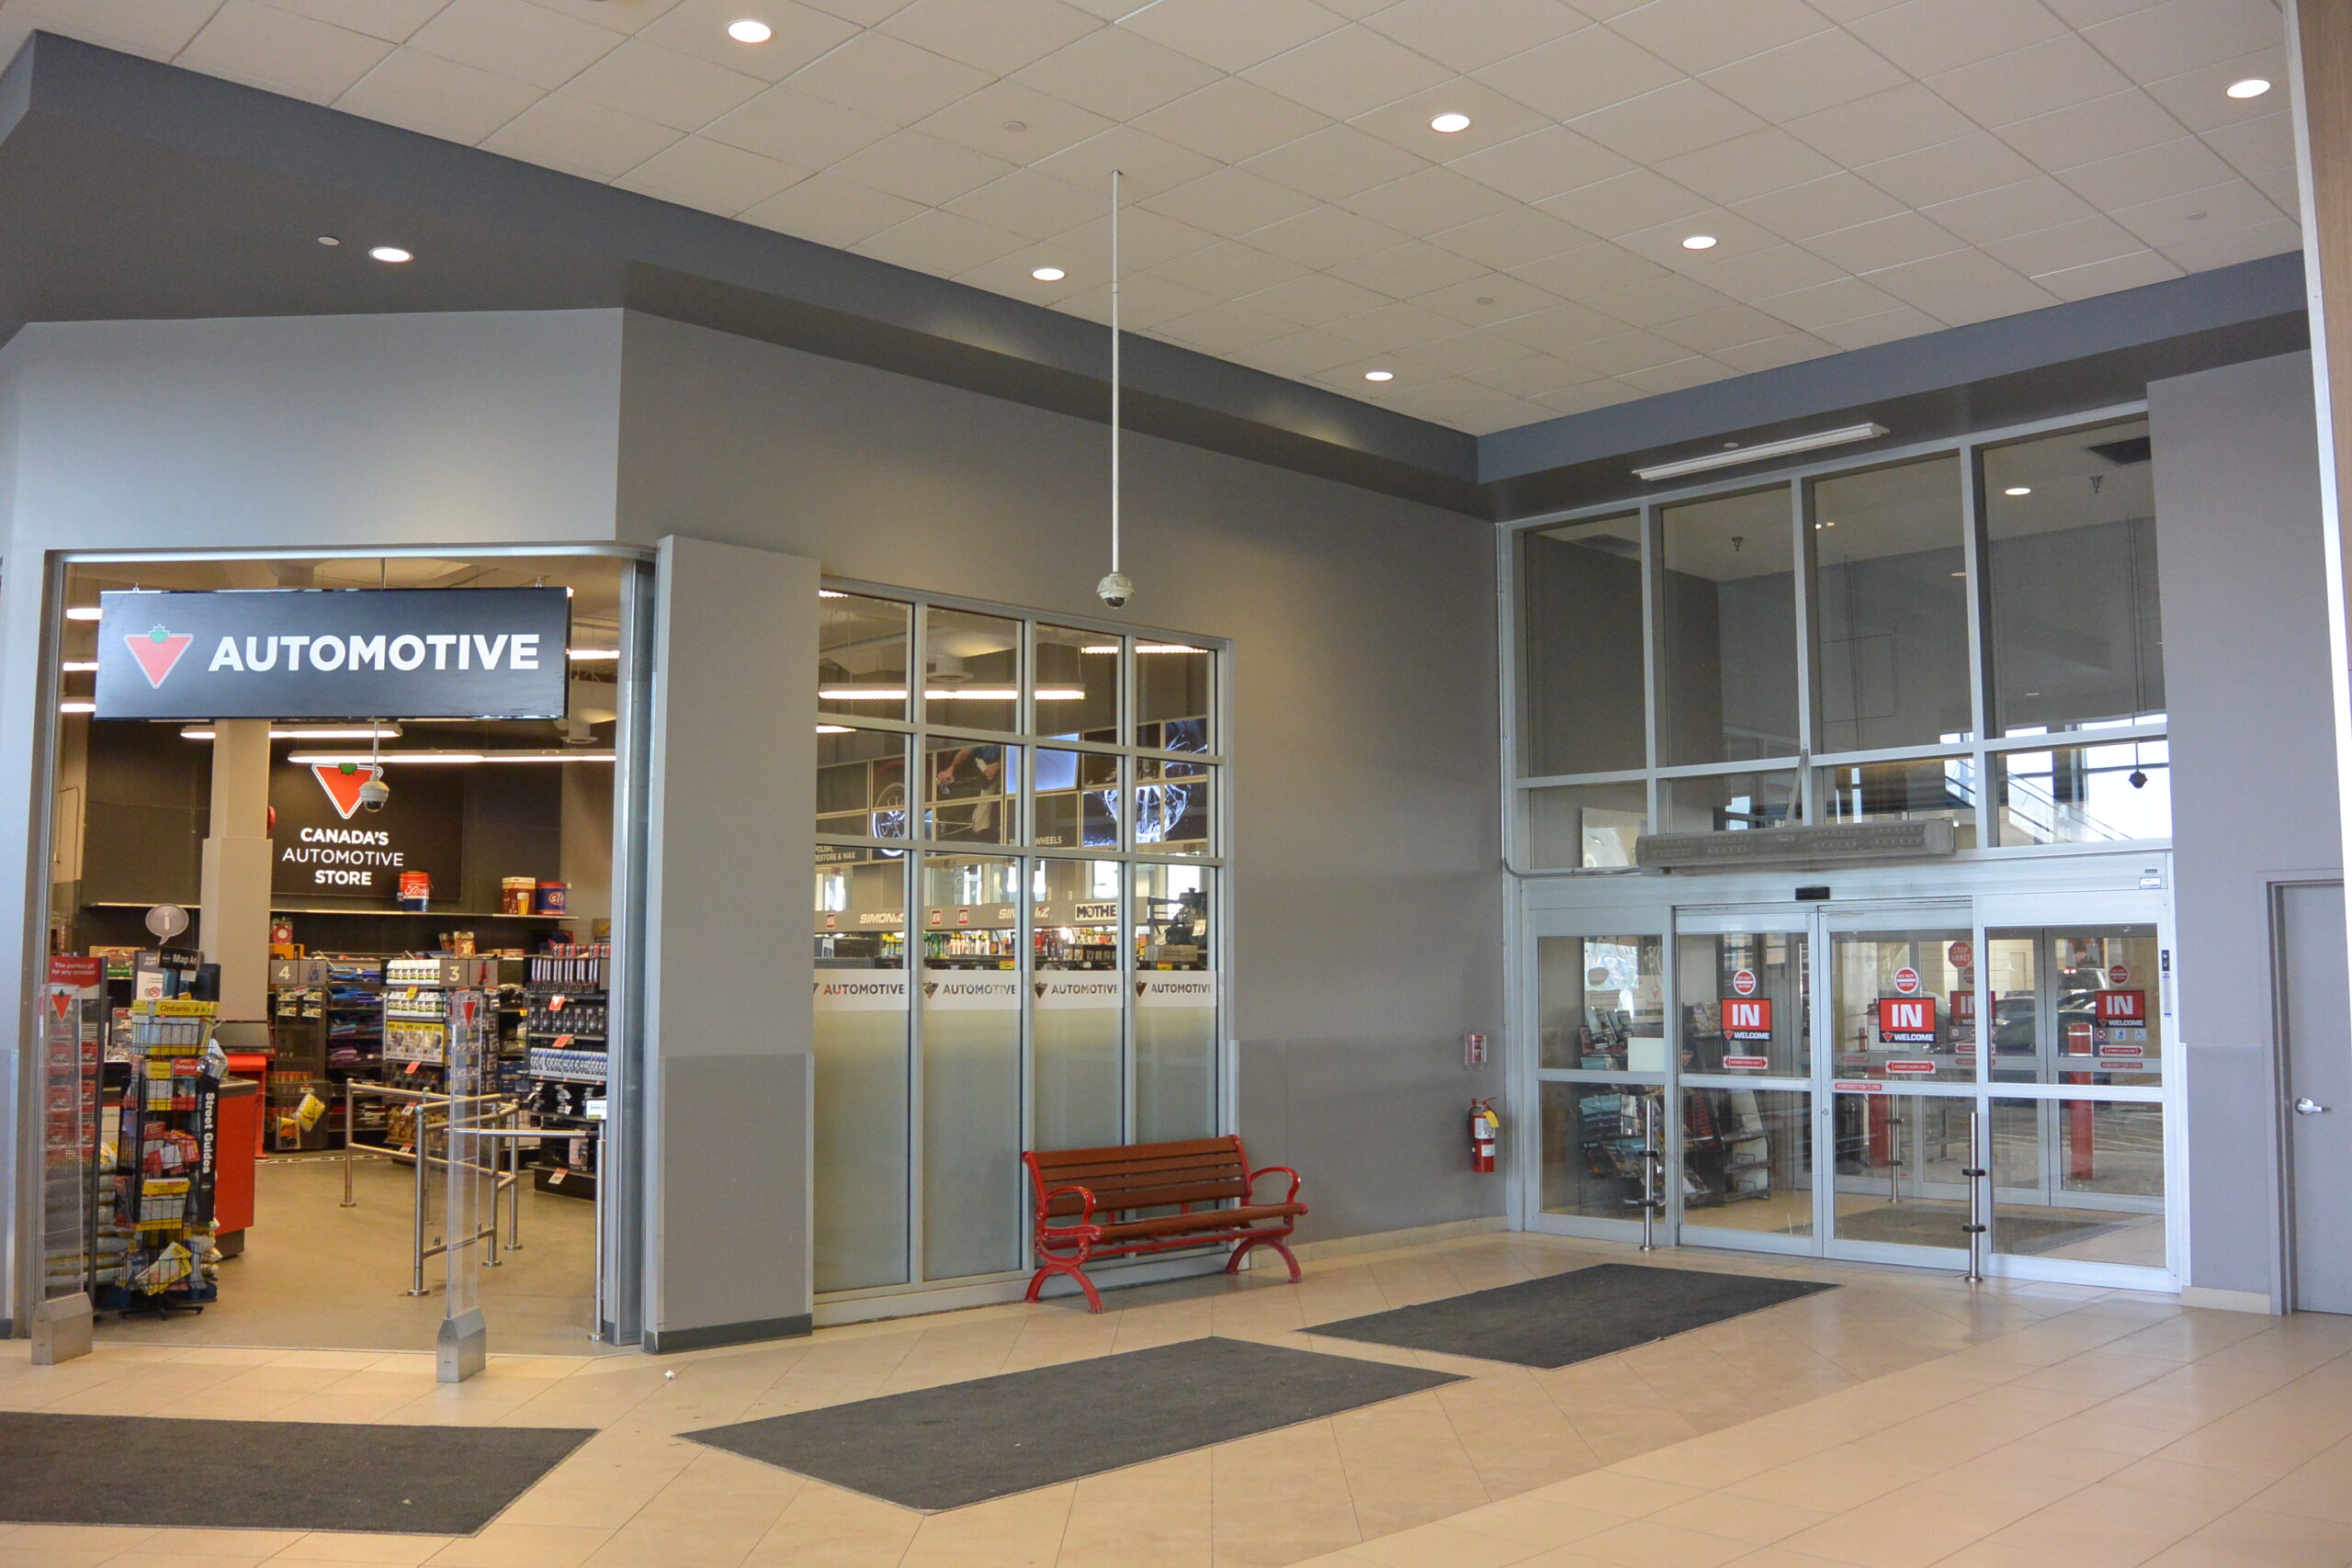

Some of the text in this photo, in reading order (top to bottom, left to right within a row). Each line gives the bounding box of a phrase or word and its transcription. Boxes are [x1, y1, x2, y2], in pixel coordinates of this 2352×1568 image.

[208, 634, 539, 671] AUTOMOTIVE
[300, 828, 390, 846] CANADA'S
[1035, 836, 1062, 845] WHEELS
[282, 847, 404, 866] AUTOMOTIVE
[314, 870, 372, 886] STORE
[173, 954, 189, 966] Map
[278, 965, 291, 980] 4
[448, 965, 460, 981] 3
[823, 984, 905, 996] AUTOMOTIVE
[943, 984, 1016, 996] AUTOMOTIVE
[1050, 984, 1117, 995] AUTOMOTIVE
[2106, 996, 2133, 1015] IN
[1732, 1003, 1759, 1026] IN
[1892, 1004, 1923, 1027] IN
[1734, 1032, 1770, 1040] WELCOME
[1894, 1033, 1934, 1042] WELCOME
[202, 1092, 215, 1174] Street Guides
